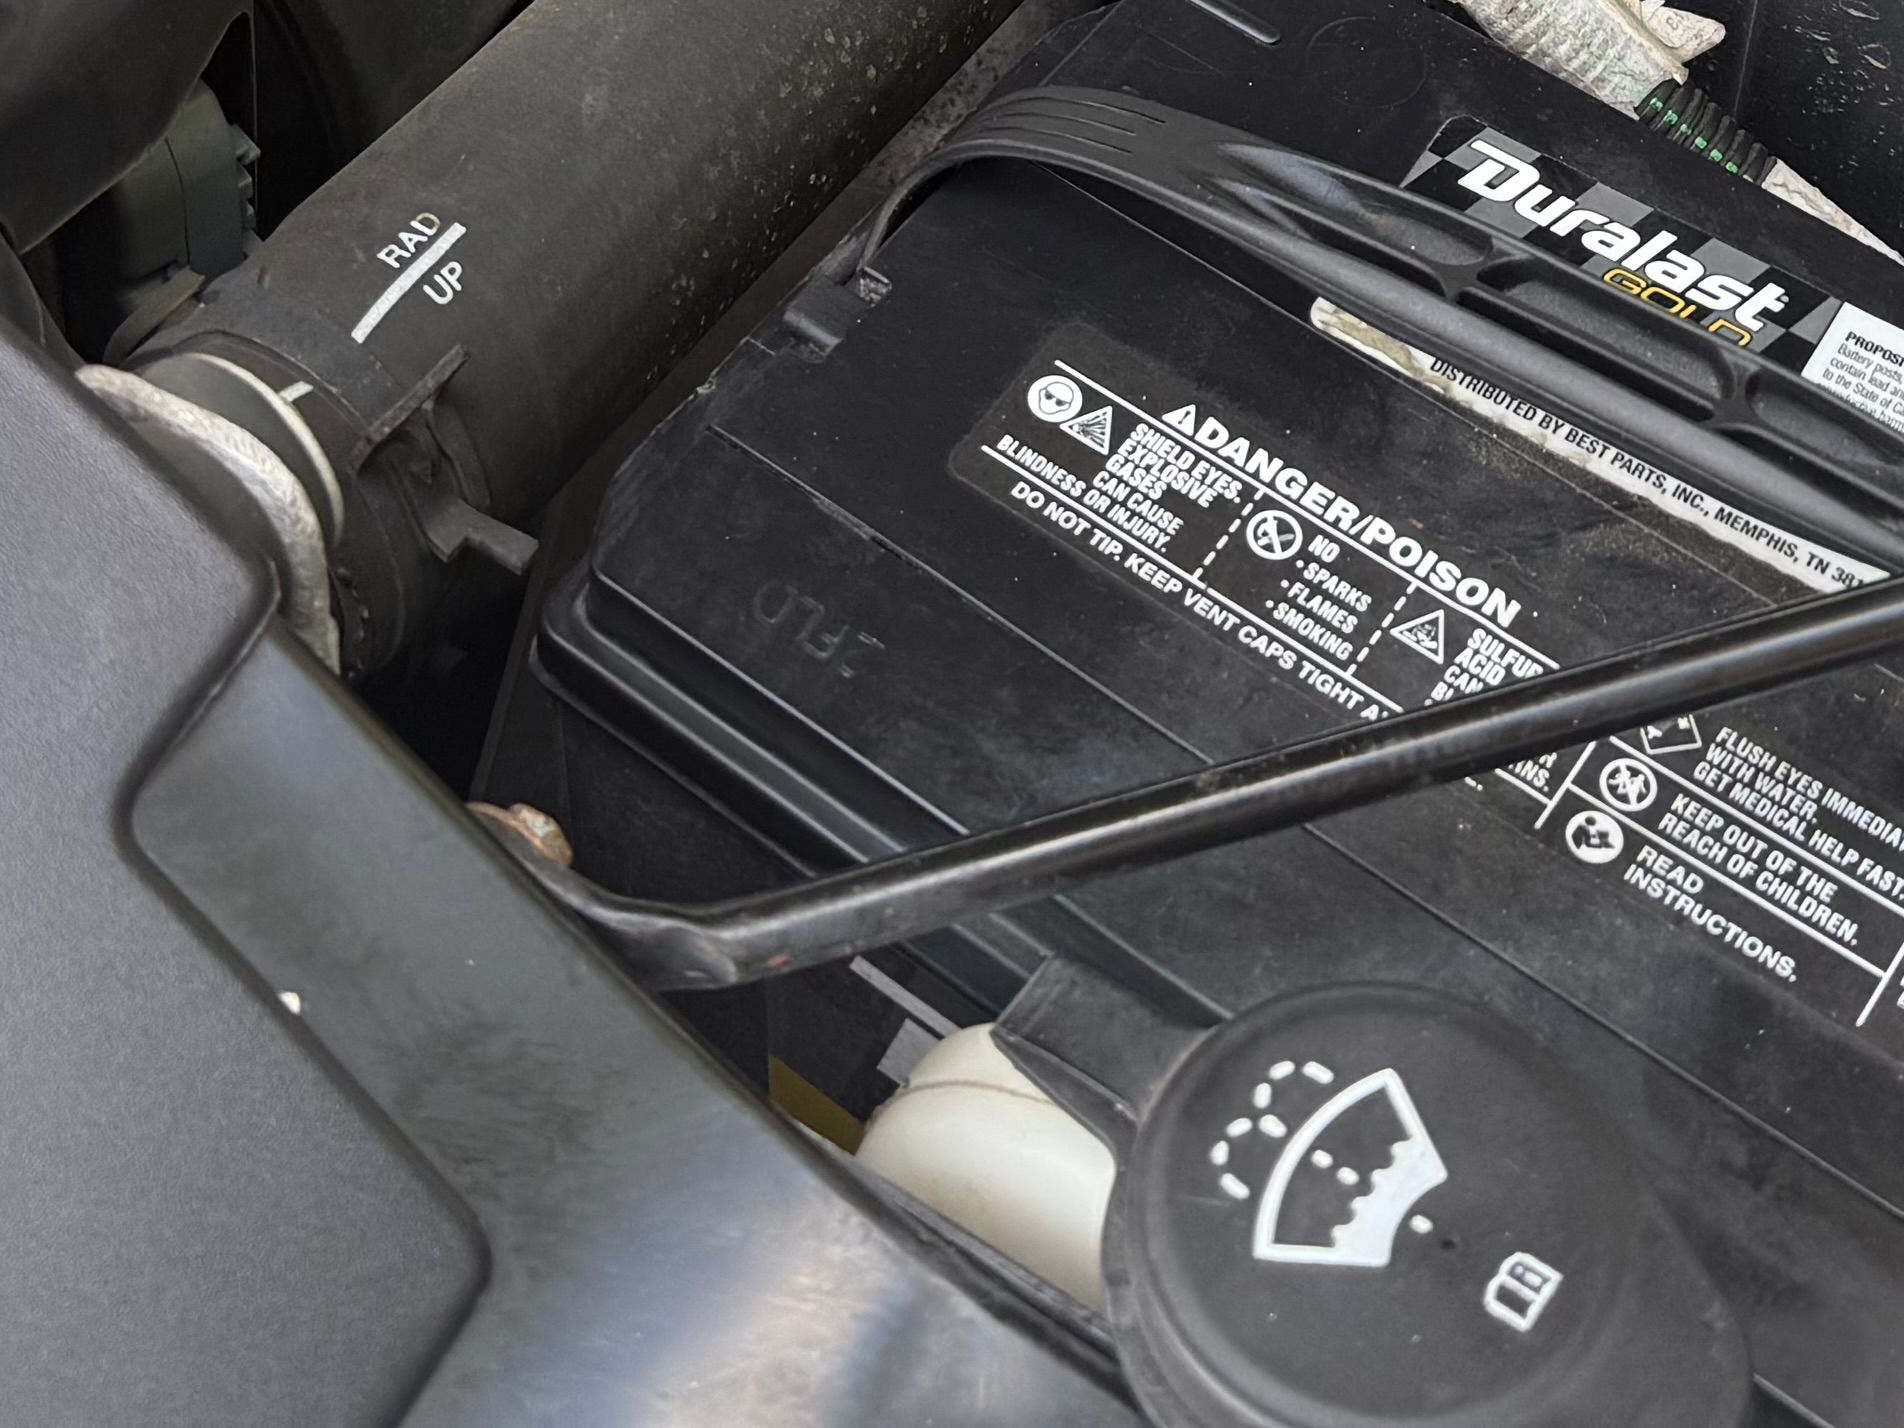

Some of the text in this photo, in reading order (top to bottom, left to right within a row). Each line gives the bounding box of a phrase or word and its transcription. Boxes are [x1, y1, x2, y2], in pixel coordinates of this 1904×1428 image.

[377, 212, 441, 268] RAD
[1457, 140, 1788, 332] Duralast
[423, 261, 463, 305] UP
[1822, 368, 1834, 381] to
[1835, 374, 1852, 390] the
[1853, 383, 1879, 403] State
[1880, 397, 1893, 409] of
[1830, 357, 1867, 381] contain
[1867, 374, 1890, 392] lead
[1837, 343, 1875, 369] Battery
[996, 434, 1171, 553] BLINDNESS OR INJURY.
[1105, 454, 1167, 500] GASES
[1117, 438, 1218, 508] EXPLOSIVE
[1130, 423, 1242, 504] SHIELD EYES.
[1430, 357, 1537, 422] DISTRIBUTED
[1539, 413, 1565, 435] BY
[1565, 427, 1611, 459] BEST
[1610, 451, 1668, 494] PARTS,
[1672, 483, 1709, 517] INC.,
[1714, 506, 1799, 563] MEMPHIS,
[1805, 551, 1831, 575] TN
[1093, 471, 1184, 535] CAN CAUSE
[1194, 415, 1522, 628] DANGER/POISON
[1308, 534, 1341, 563] NO
[1011, 481, 1045, 508] DO
[1043, 502, 1091, 535] NOT
[1089, 528, 1123, 561] TIP.
[1124, 553, 1183, 593] KEEP
[1183, 588, 1241, 631] VENT
[1238, 625, 1297, 670] CAPS
[1298, 660, 1365, 710] TIGHT
[1454, 647, 1506, 686] ACID
[1706, 743, 1818, 824] WITH WATER.
[1715, 726, 1777, 772] FLUSH
[1775, 761, 1824, 799] EYES
[1671, 793, 1838, 903] KEEP OUT OF THE
[1693, 761, 1733, 793] GET
[1728, 782, 1807, 841] MEDICAL
[1808, 829, 1860, 866] HELP
[1637, 845, 1704, 893] READ
[1658, 812, 1858, 945] REACH OF CHILDREN.
